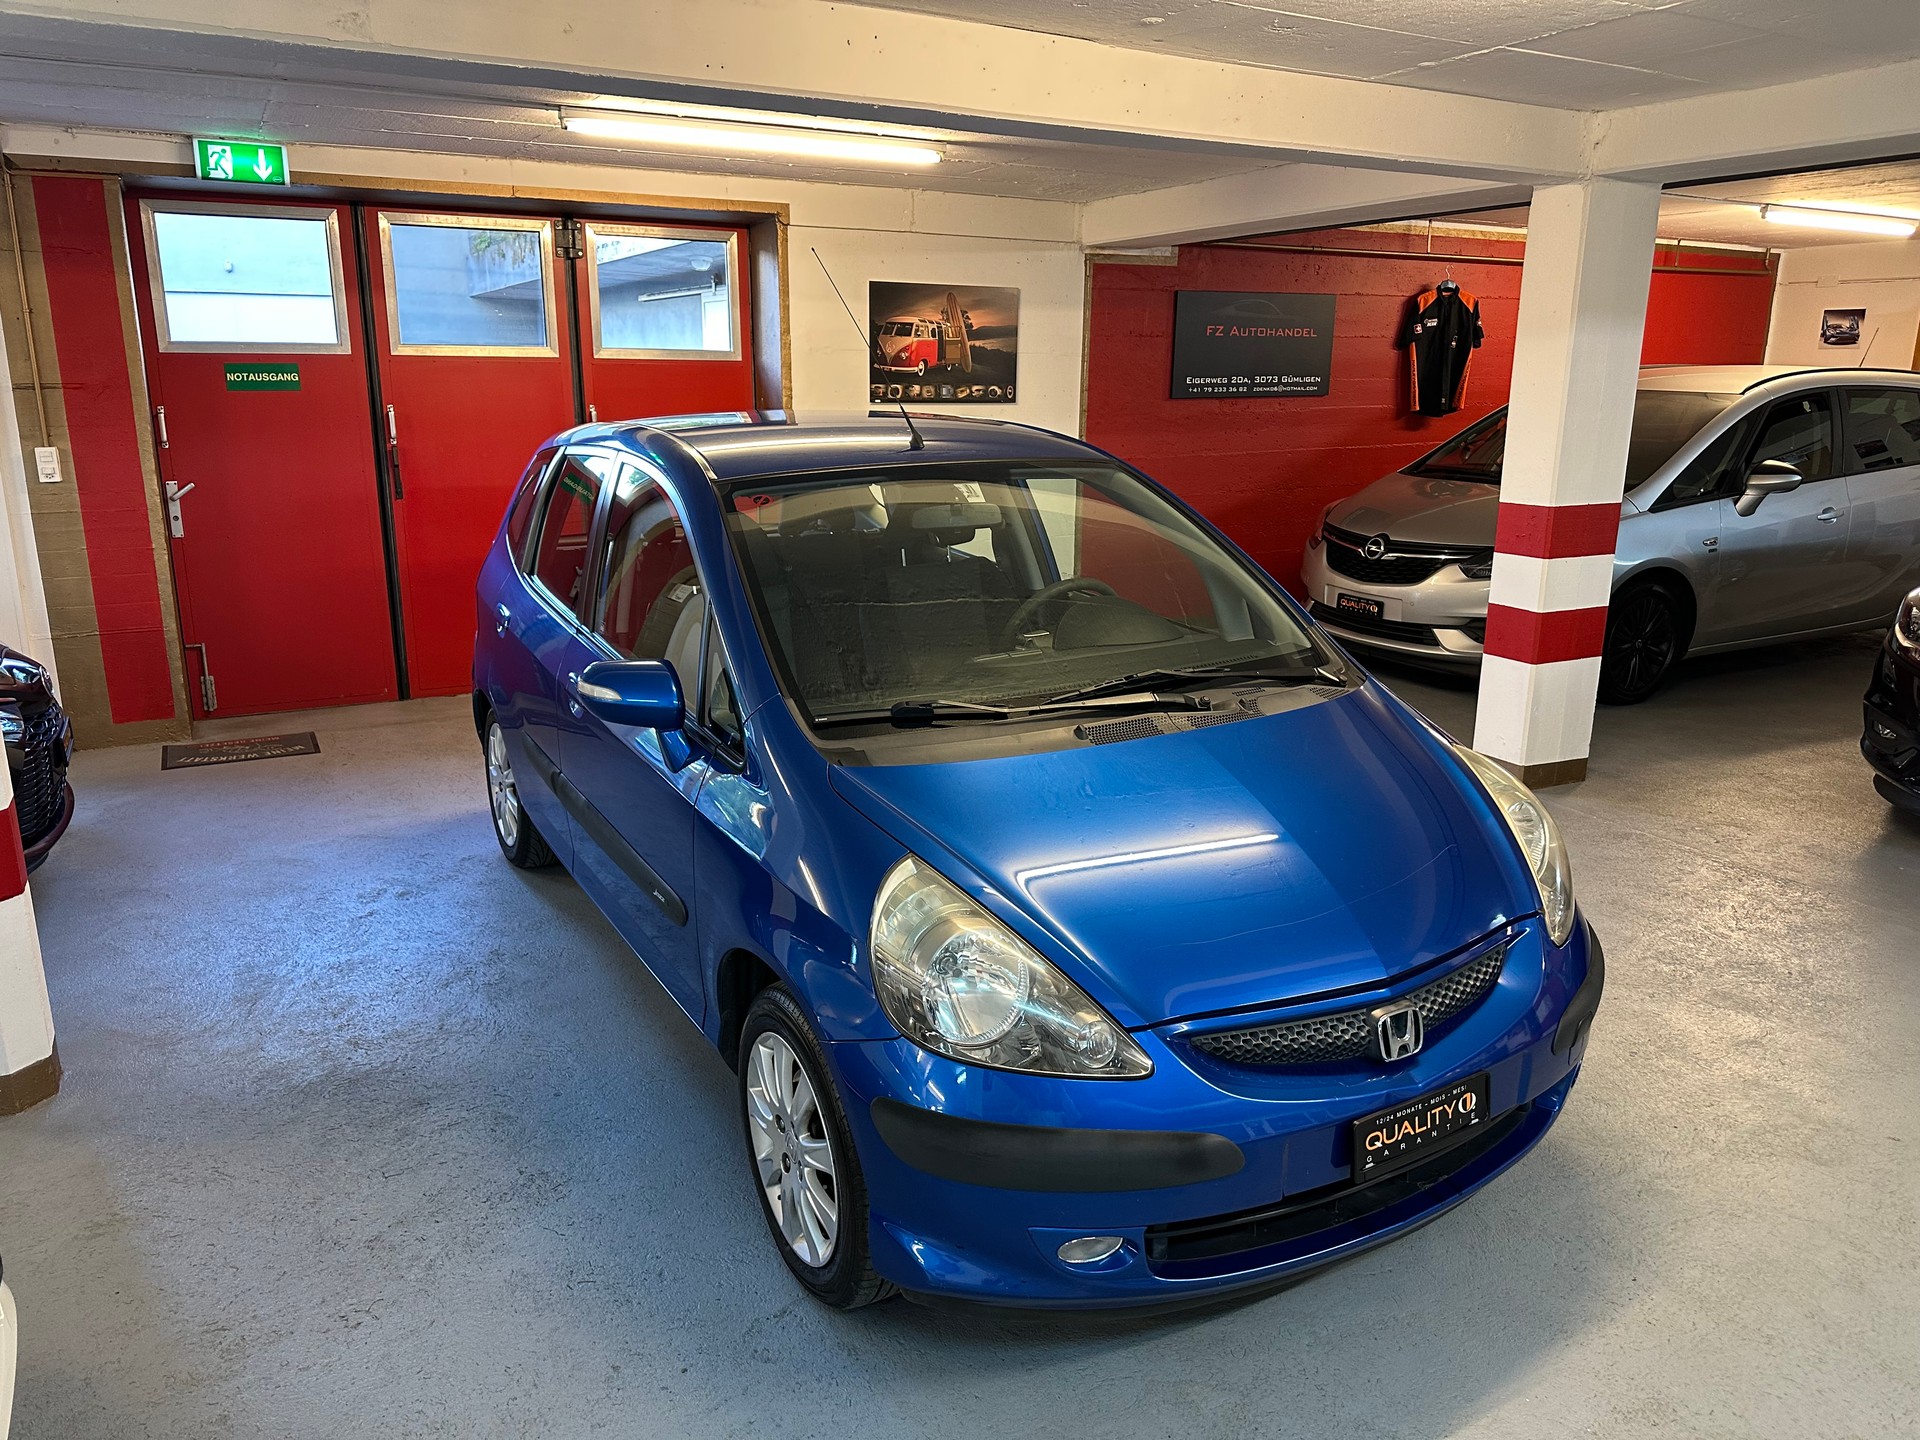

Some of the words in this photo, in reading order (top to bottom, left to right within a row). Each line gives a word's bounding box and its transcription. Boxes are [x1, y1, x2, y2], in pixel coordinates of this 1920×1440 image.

[1206, 325, 1224, 337] FZ
[1229, 325, 1317, 337] AUTOHANDEL
[226, 372, 299, 381] NOTAUSGANG
[1186, 376, 1228, 384] EIGERWEG
[1254, 375, 1278, 383] 3073
[1340, 598, 1371, 610] QUALITY
[1375, 1114, 1394, 1125] 12/24
[1396, 1103, 1423, 1118] MONATE
[1430, 1093, 1446, 1105] MOIS
[1452, 1084, 1467, 1095] MESI
[1365, 1099, 1457, 1151] QUALITY
[1366, 1111, 1476, 1163] GARANTIE
